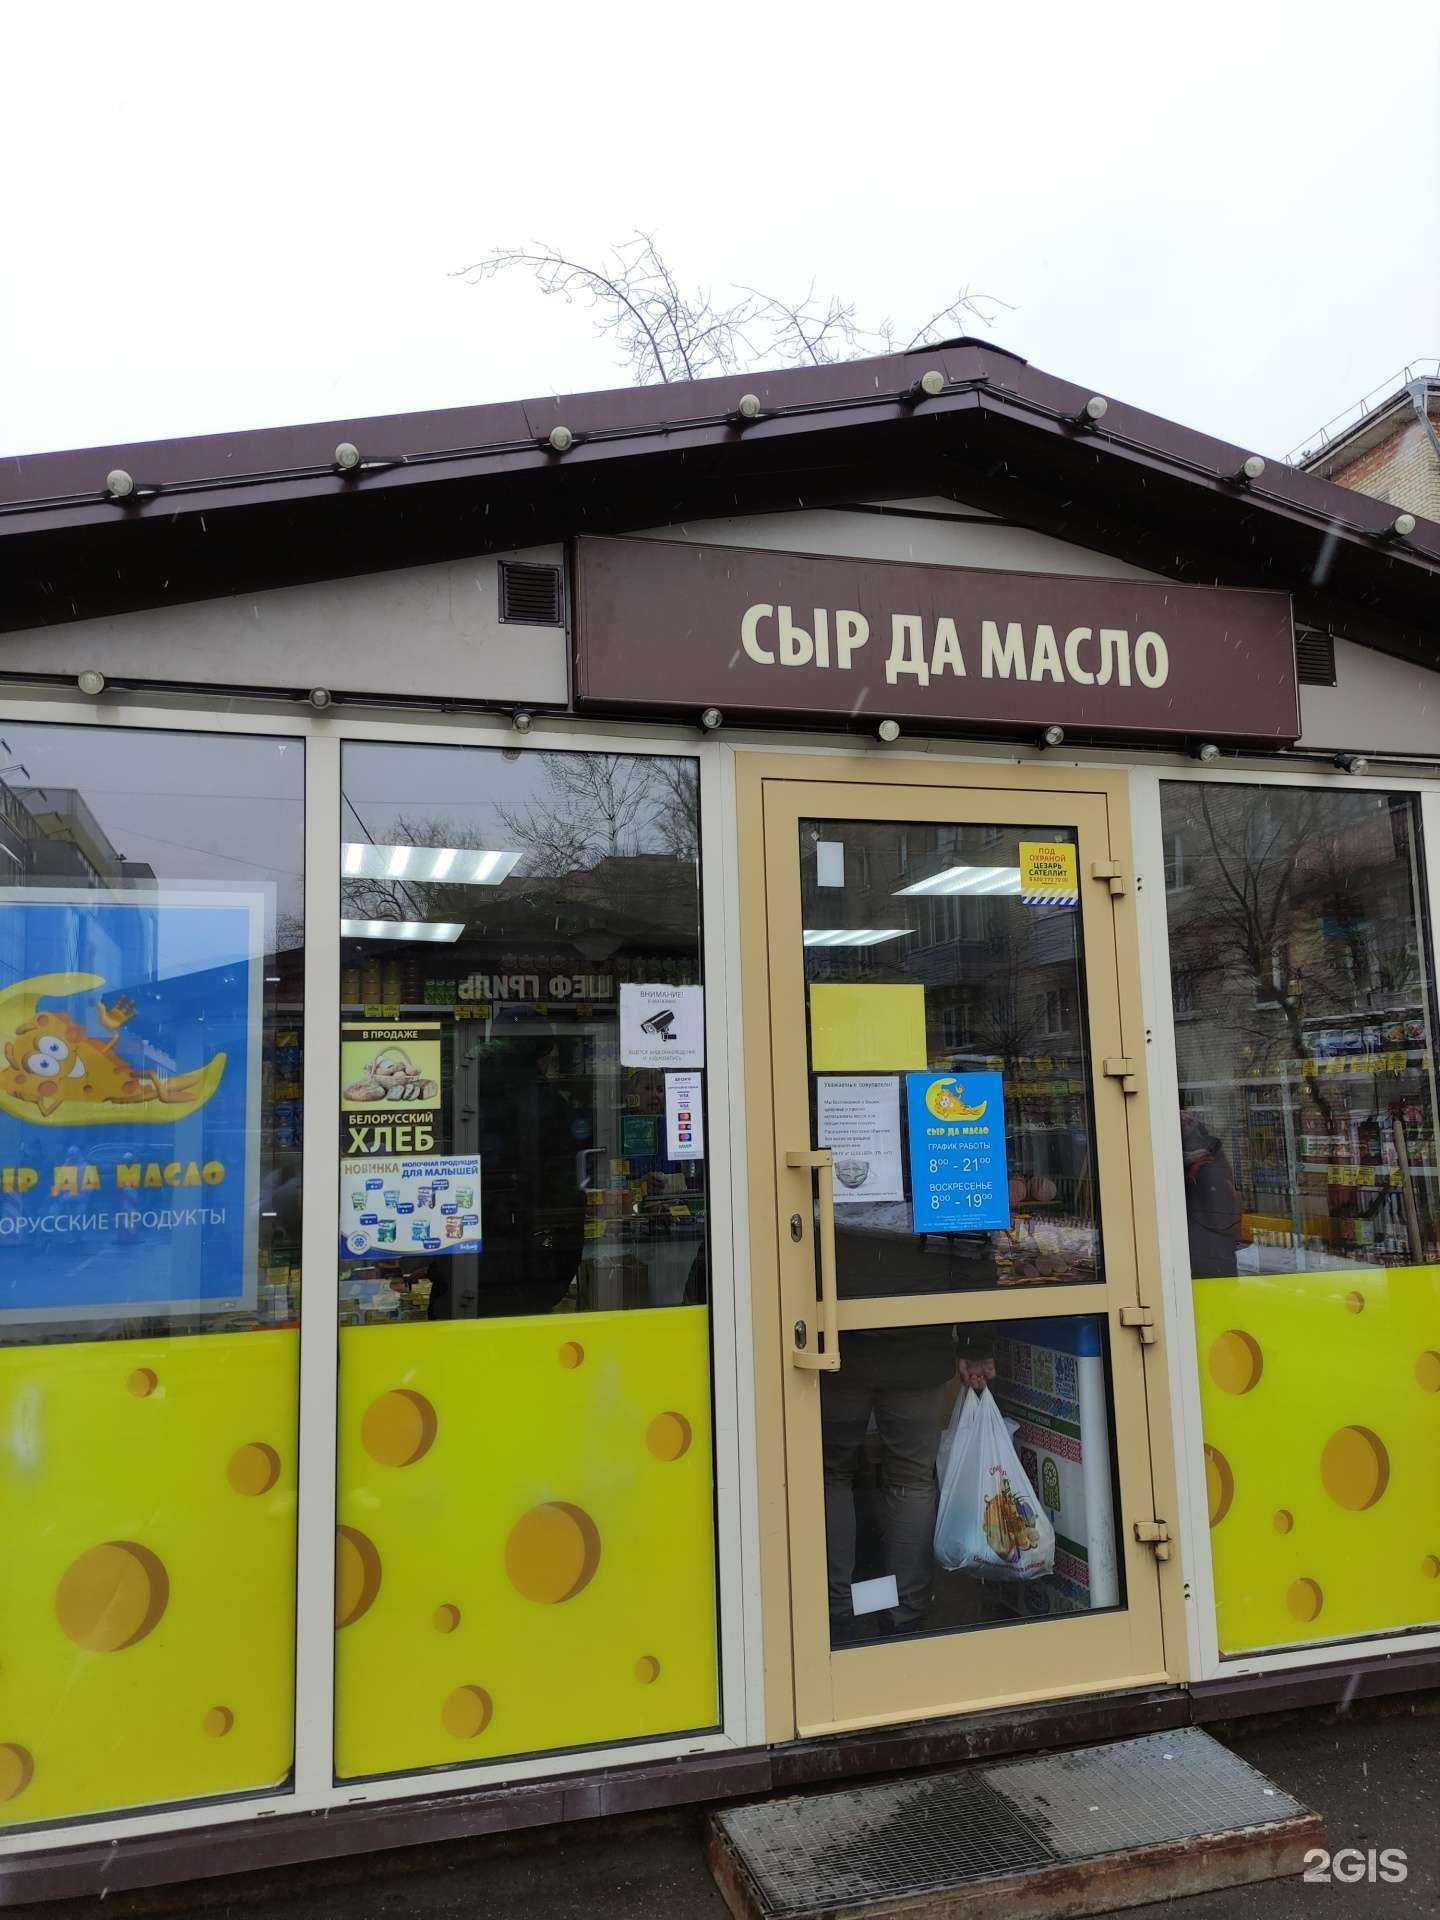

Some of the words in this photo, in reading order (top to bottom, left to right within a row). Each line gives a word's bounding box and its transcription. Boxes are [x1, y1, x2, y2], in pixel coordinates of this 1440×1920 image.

[740, 603, 870, 670] СЫР
[885, 613, 966, 686] ДА
[981, 620, 1169, 689] МАСЛО
[362, 1030, 369, 1039] В
[370, 1030, 419, 1040] ПРОДАЖЕ
[348, 1112, 434, 1125] БЕЛОРУССКИЙ
[347, 1125, 434, 1153] ХЛЕБ
[928, 1143, 957, 1151] ГРАФИК
[344, 1162, 400, 1175] НОВИНКА
[402, 1168, 423, 1179] ДЛЯ
[424, 1166, 479, 1177] МАЛЫШЕЙ
[51, 1164, 101, 1197] ДА
[115, 1160, 226, 1189] МАСЛО
[929, 1181, 993, 1192] ВОСКРЕСЕНЬЕ
[114, 1207, 227, 1231] ПРОДУКТЫ
